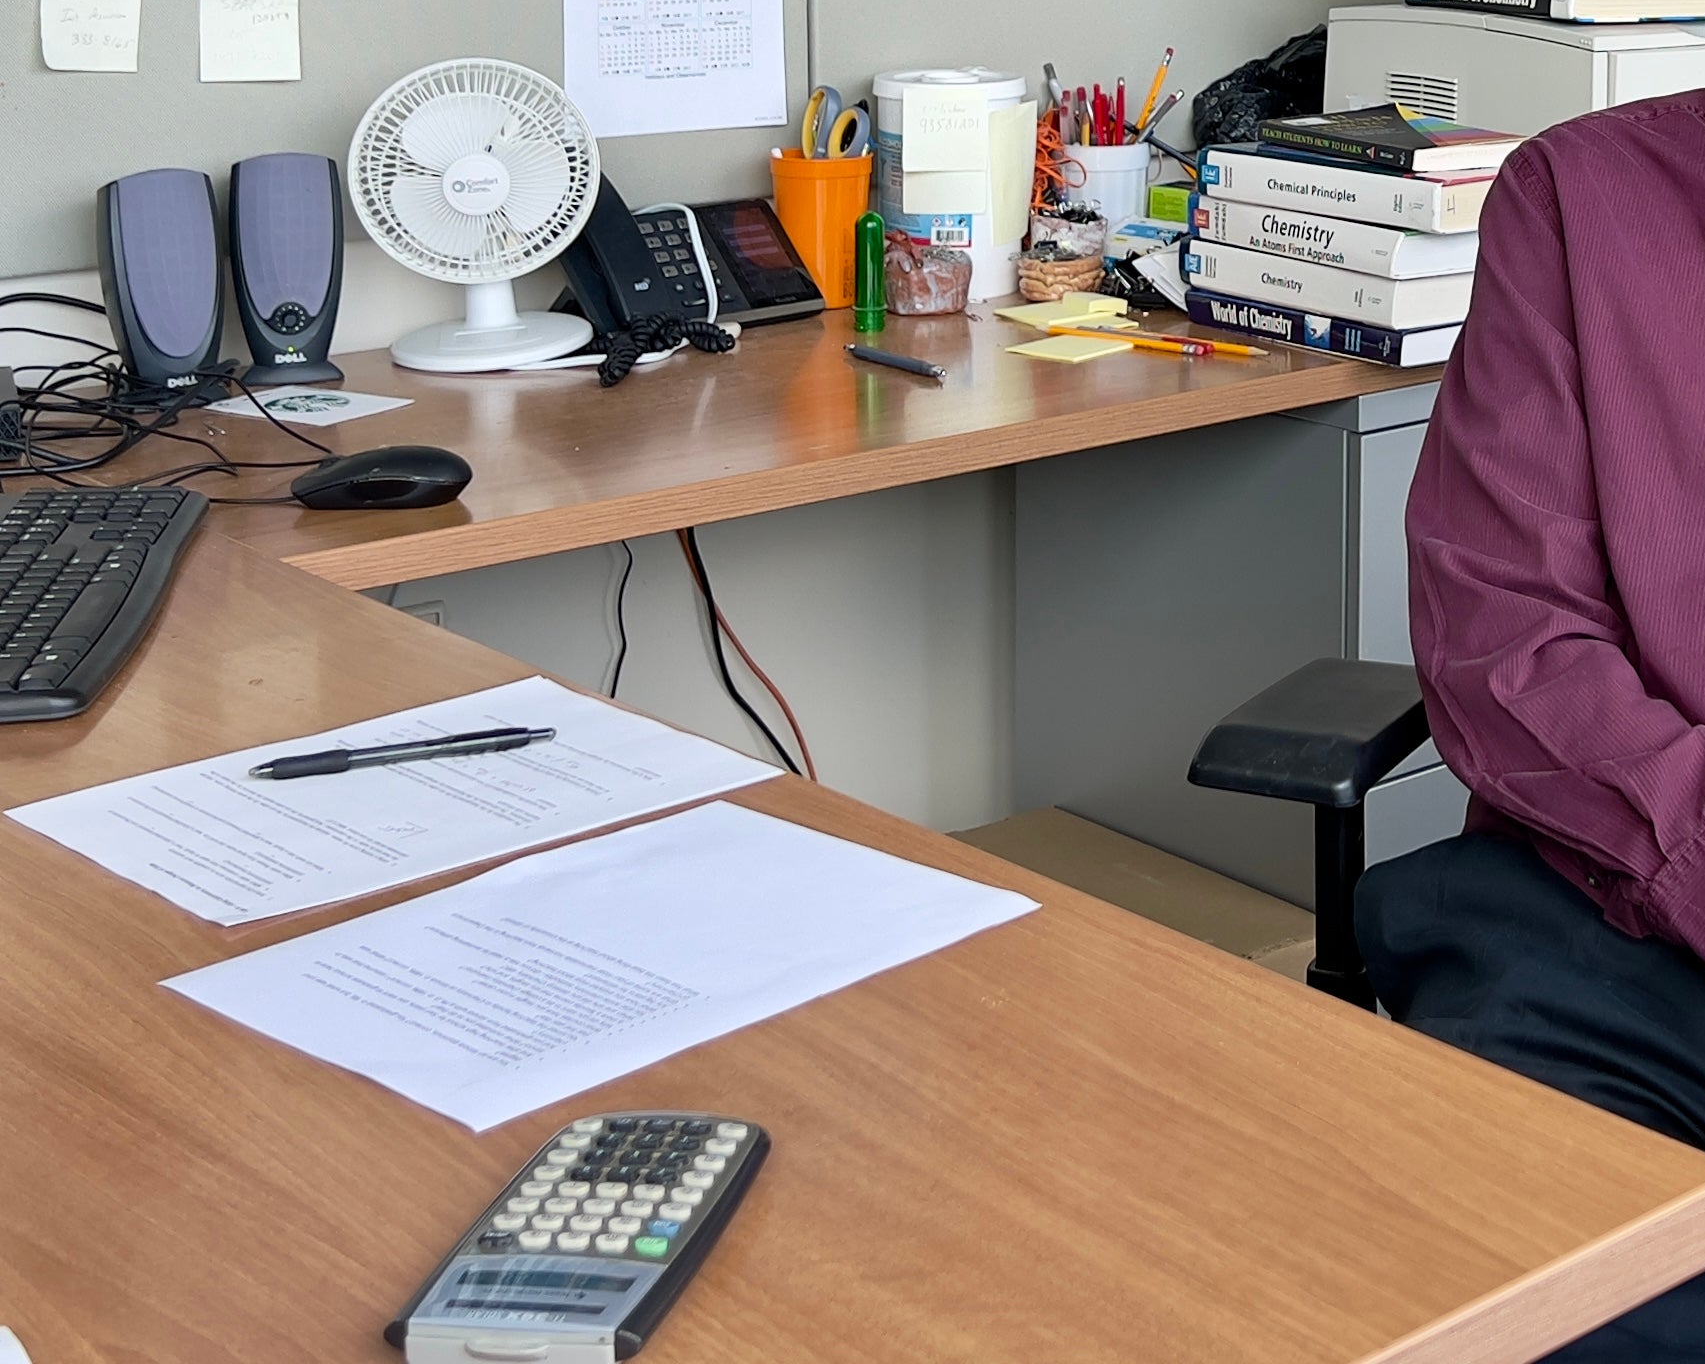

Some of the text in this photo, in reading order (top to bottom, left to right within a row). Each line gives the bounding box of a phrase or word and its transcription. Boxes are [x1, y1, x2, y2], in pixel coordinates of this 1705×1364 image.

[1262, 126, 1363, 155] TEACH STUDENTS HOW TO LEARN
[1203, 168, 1218, 182] IE
[1267, 177, 1357, 204] Chemical Principles
[1196, 210, 1209, 226] IE
[1261, 213, 1335, 250] Chemistry
[1249, 235, 1345, 265] An Atoms First Approach
[1261, 271, 1304, 295] Chemistry
[1210, 299, 1294, 342] World of Chemistry
[275, 352, 307, 365] DELL
[167, 374, 199, 389] DELL
